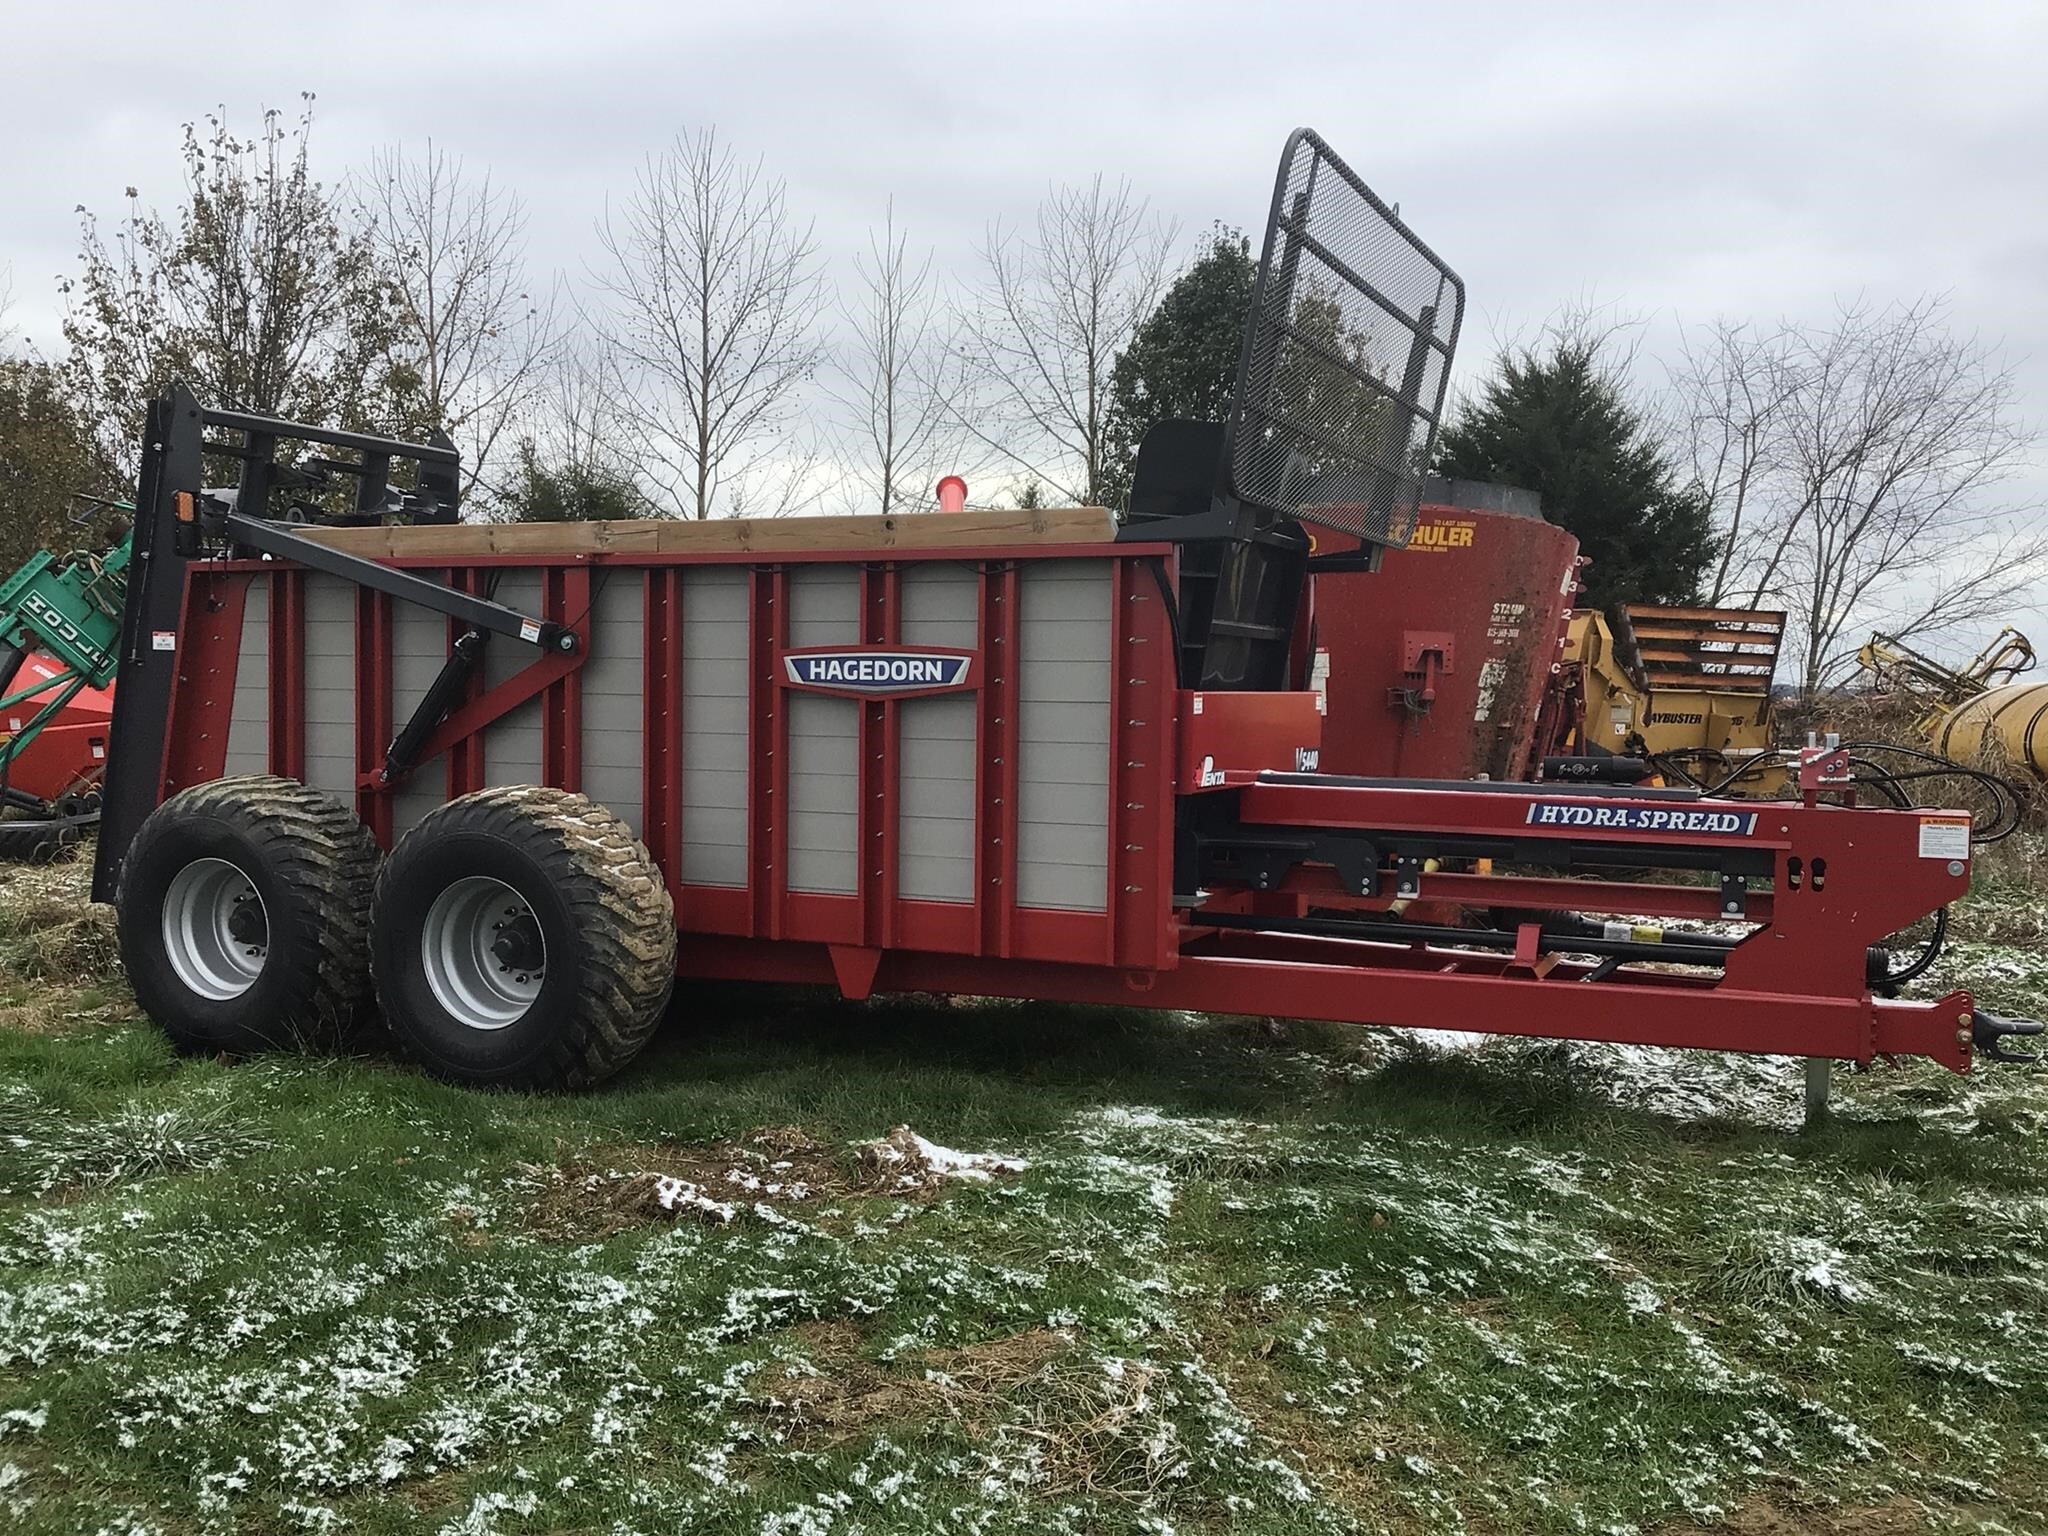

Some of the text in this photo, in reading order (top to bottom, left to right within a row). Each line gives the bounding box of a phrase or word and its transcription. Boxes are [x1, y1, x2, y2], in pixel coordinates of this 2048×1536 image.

[1568, 581, 1578, 593] 3
[1561, 608, 1572, 620] 2
[26, 595, 109, 668] HOULE
[1558, 637, 1566, 649] 1
[809, 660, 942, 681] HAGEDORN
[1551, 663, 1561, 674] C
[1201, 756, 1225, 787] PENTA
[1540, 805, 1740, 832] HYDRA-SPREAD
